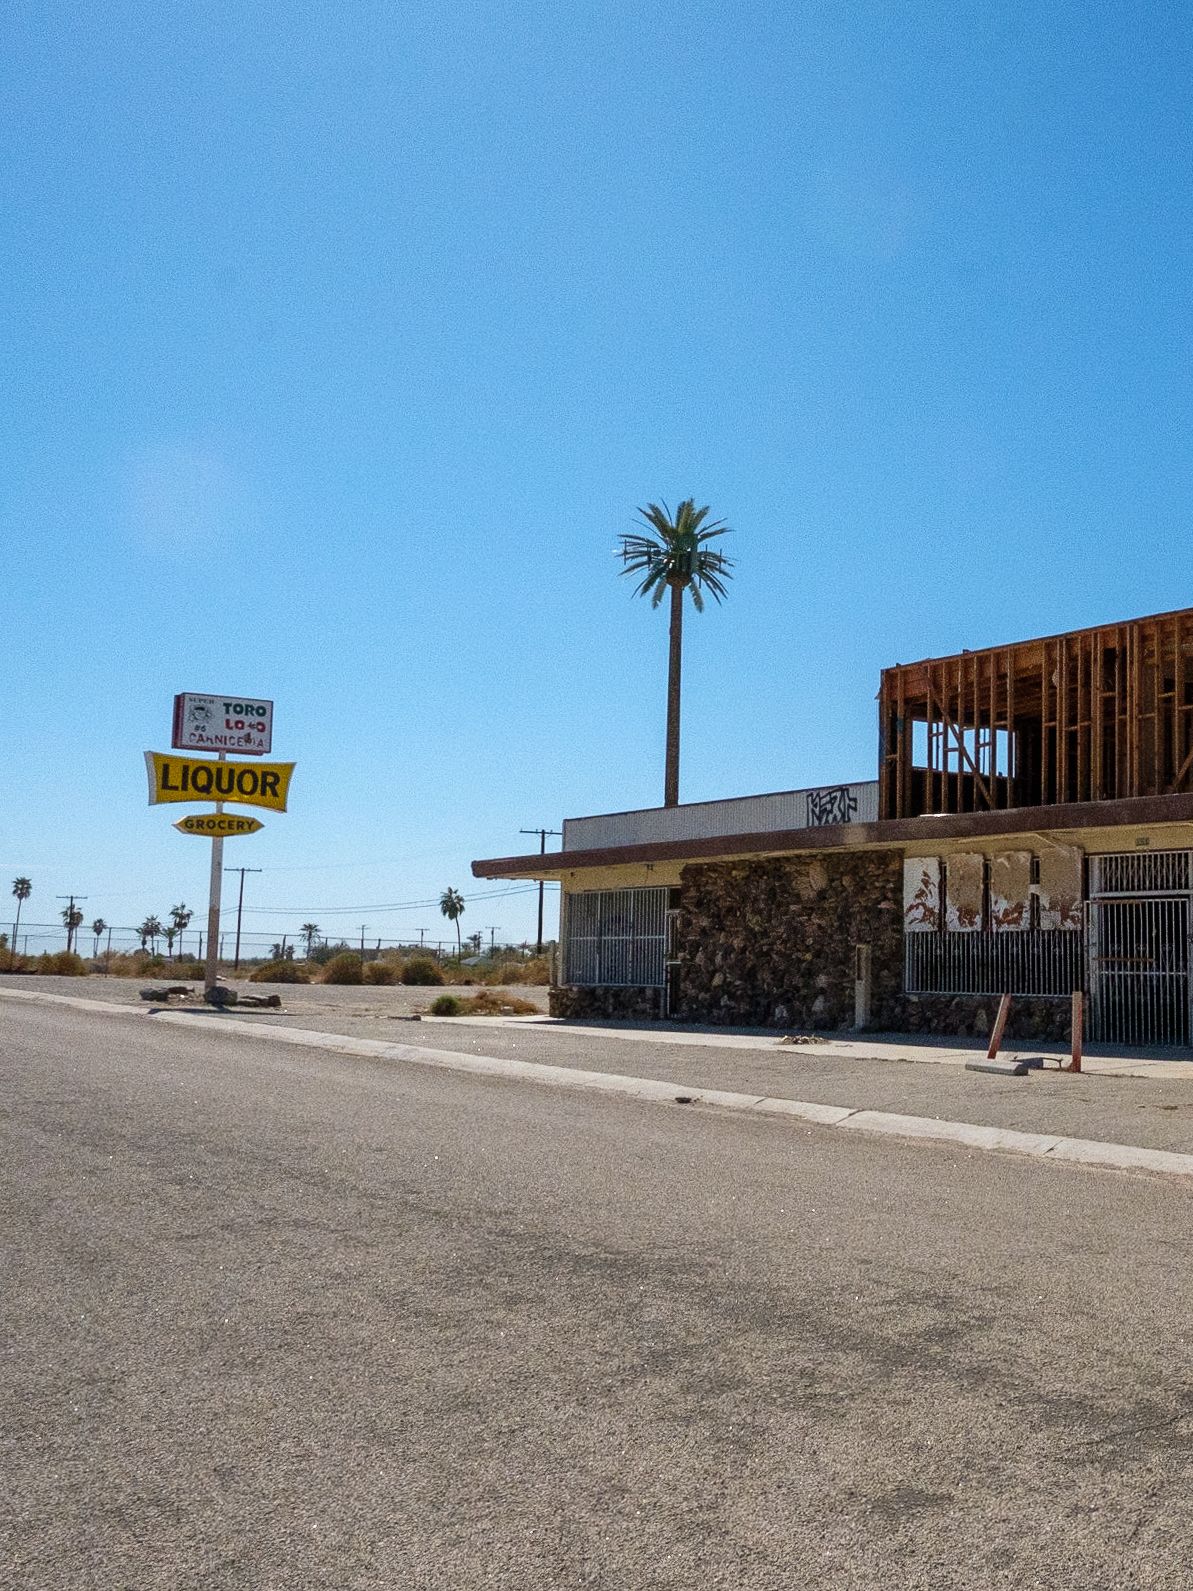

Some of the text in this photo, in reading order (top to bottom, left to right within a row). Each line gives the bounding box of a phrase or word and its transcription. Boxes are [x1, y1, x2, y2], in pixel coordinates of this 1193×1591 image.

[223, 702, 267, 717] TORO
[161, 763, 281, 798] LIQUOR
[184, 819, 254, 830] GROCERY
